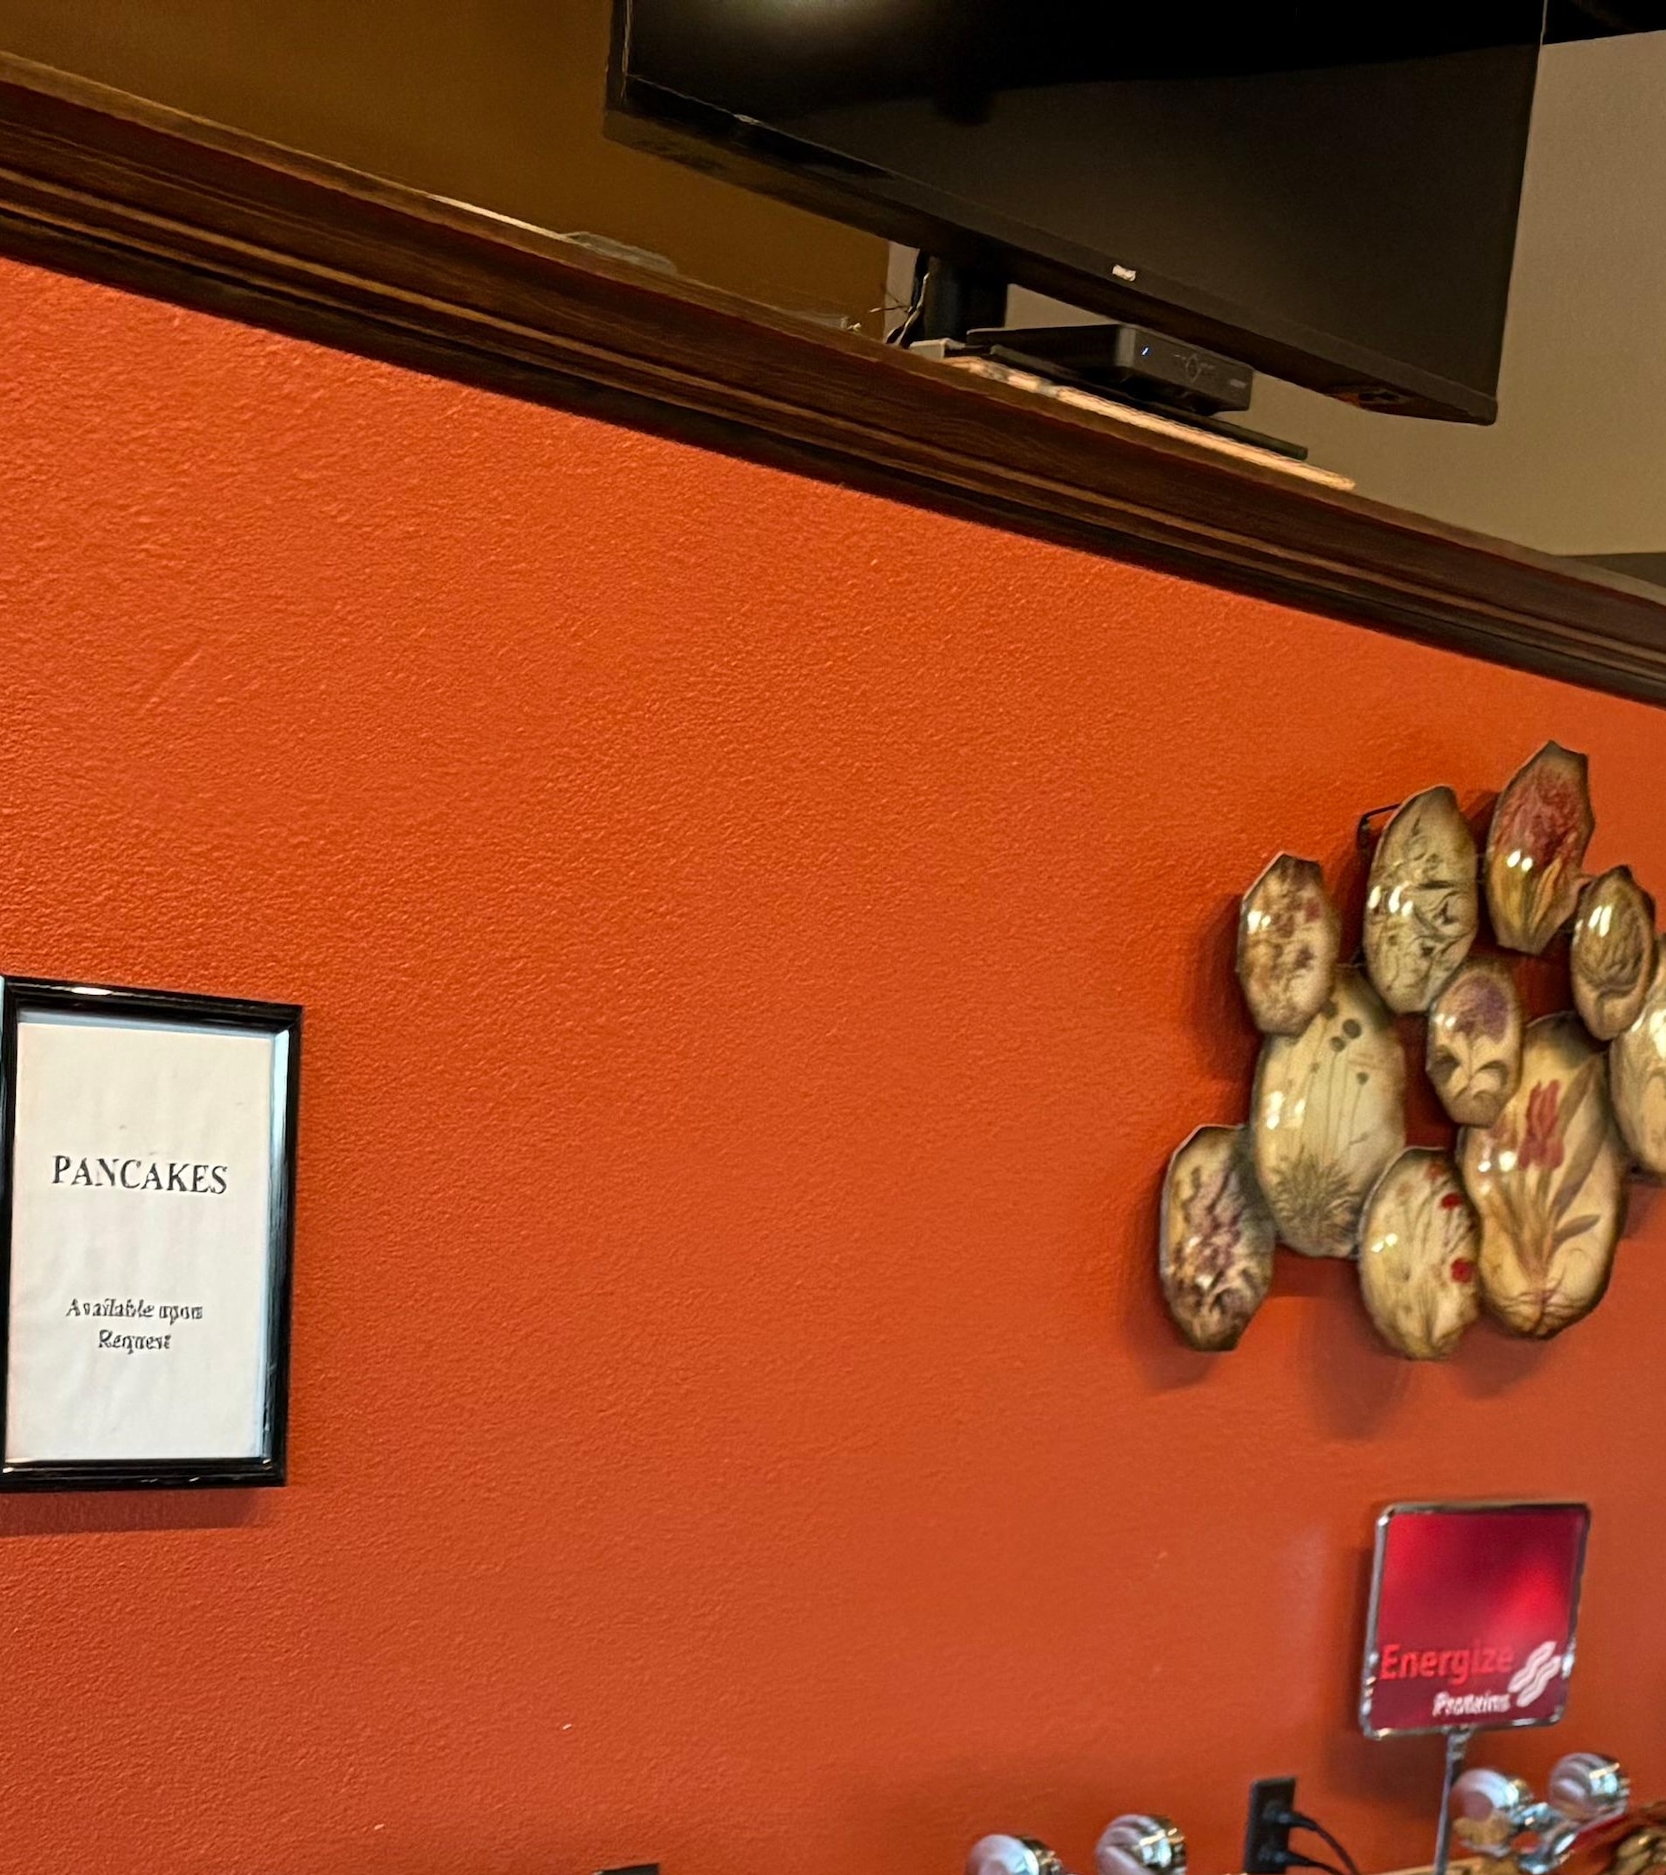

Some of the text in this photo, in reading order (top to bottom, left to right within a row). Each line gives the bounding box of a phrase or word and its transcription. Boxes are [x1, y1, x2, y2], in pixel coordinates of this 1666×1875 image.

[51, 1154, 229, 1195] PANCAKES
[65, 1298, 204, 1326] Available upon
[97, 1328, 172, 1355] Request
[1381, 1643, 1515, 1686] Energize
[1432, 1691, 1511, 1717] Proteins
